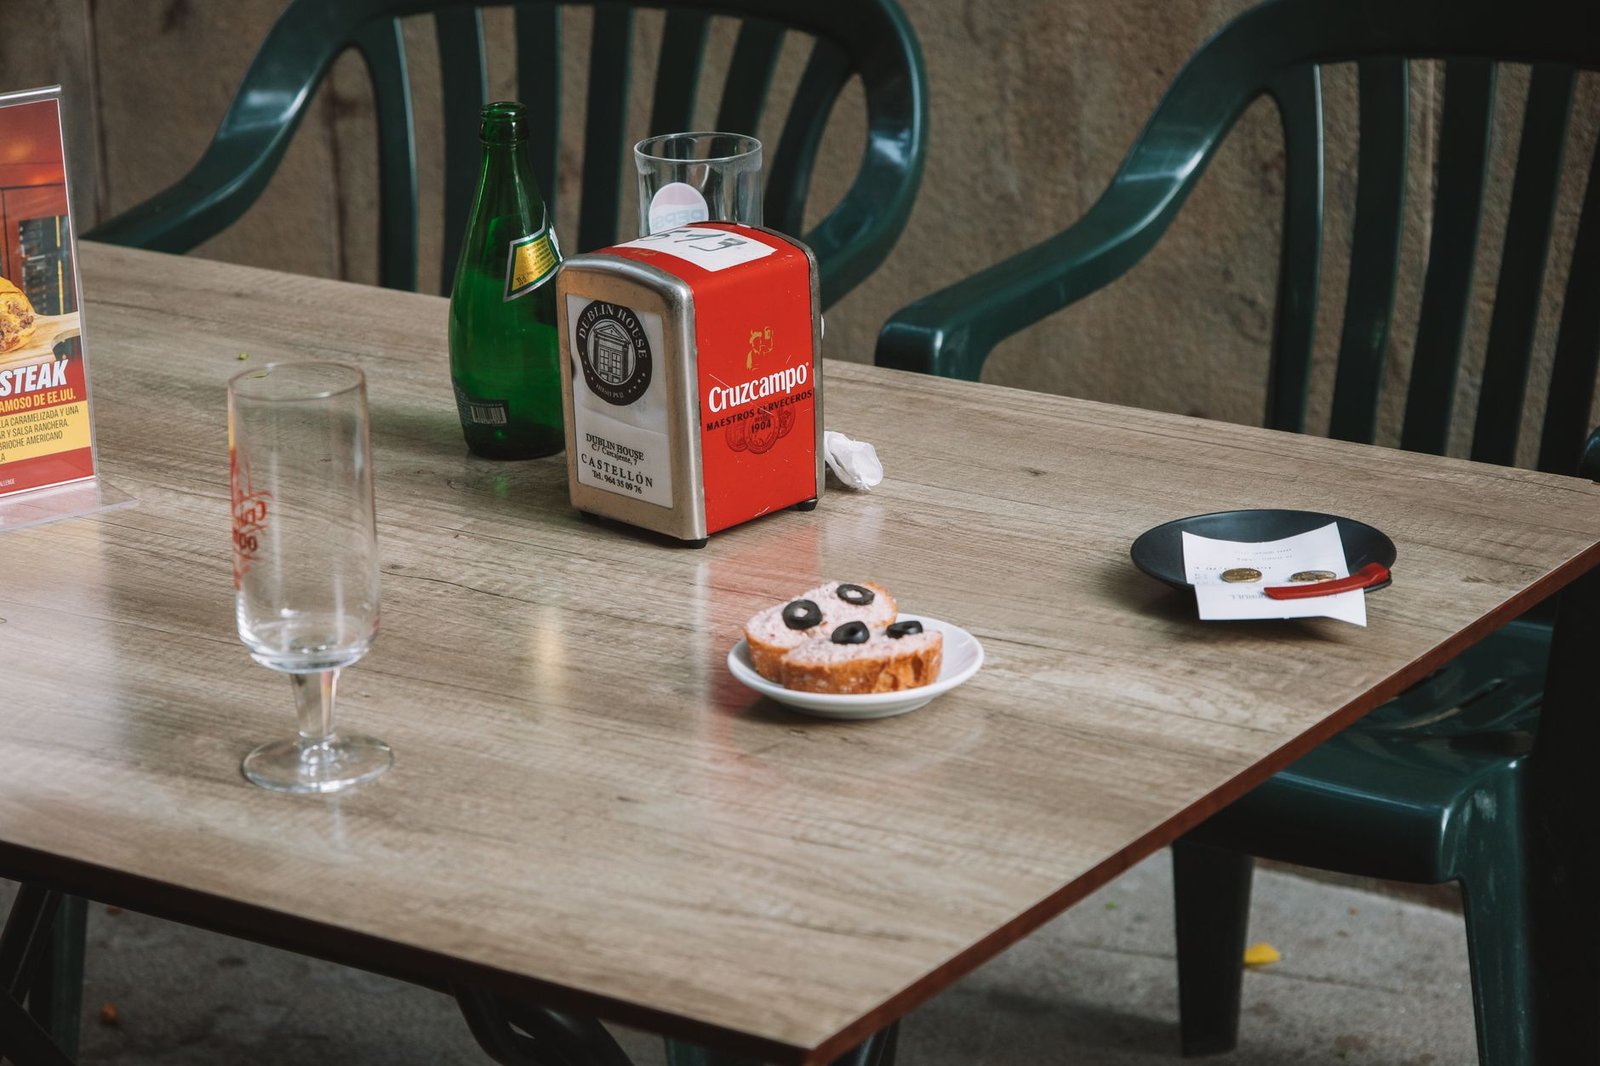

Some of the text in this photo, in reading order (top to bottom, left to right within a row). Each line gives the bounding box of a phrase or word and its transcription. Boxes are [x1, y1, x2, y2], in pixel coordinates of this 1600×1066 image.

[579, 304, 647, 359] DUBLIN HOUSE
[0, 359, 69, 397] STEAK
[708, 364, 807, 413] Cruzcampo
[33, 393, 46, 406] DE
[47, 388, 76, 404] EE.UU.
[10, 409, 59, 426] CARAMELIZADA
[60, 408, 65, 416] Y
[66, 405, 79, 415] UNA
[706, 389, 813, 432] MAESTROS CERVECEROS
[7, 429, 11, 437] Y
[12, 425, 33, 437] SALSA
[26, 430, 63, 445] AMERICANO
[751, 420, 772, 434] 1904
[586, 433, 644, 461] DUBLIN HOUSE
[591, 443, 600, 452] C/
[633, 458, 638, 466] 7
[581, 453, 653, 488] CASTELLÓN
[592, 470, 603, 480] Tel.
[604, 474, 615, 486] 964
[616, 479, 624, 488] 35
[634, 485, 642, 495] 76
